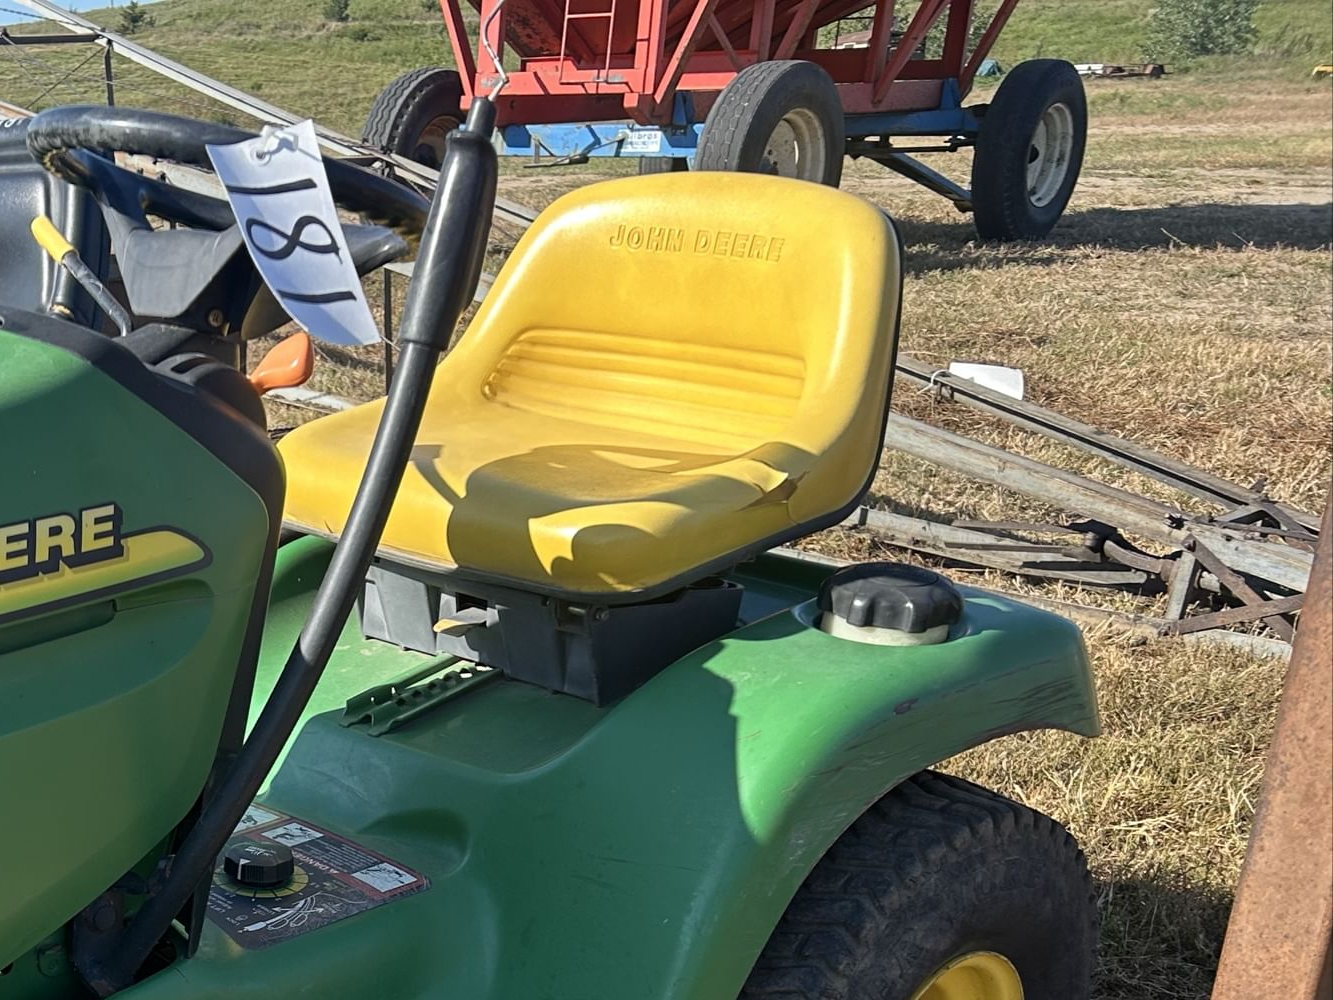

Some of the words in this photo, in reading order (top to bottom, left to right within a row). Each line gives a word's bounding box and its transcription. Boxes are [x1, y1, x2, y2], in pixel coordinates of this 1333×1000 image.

[226, 178, 357, 304] 181
[609, 225, 685, 253] JOHN
[693, 229, 786, 263] DEERE
